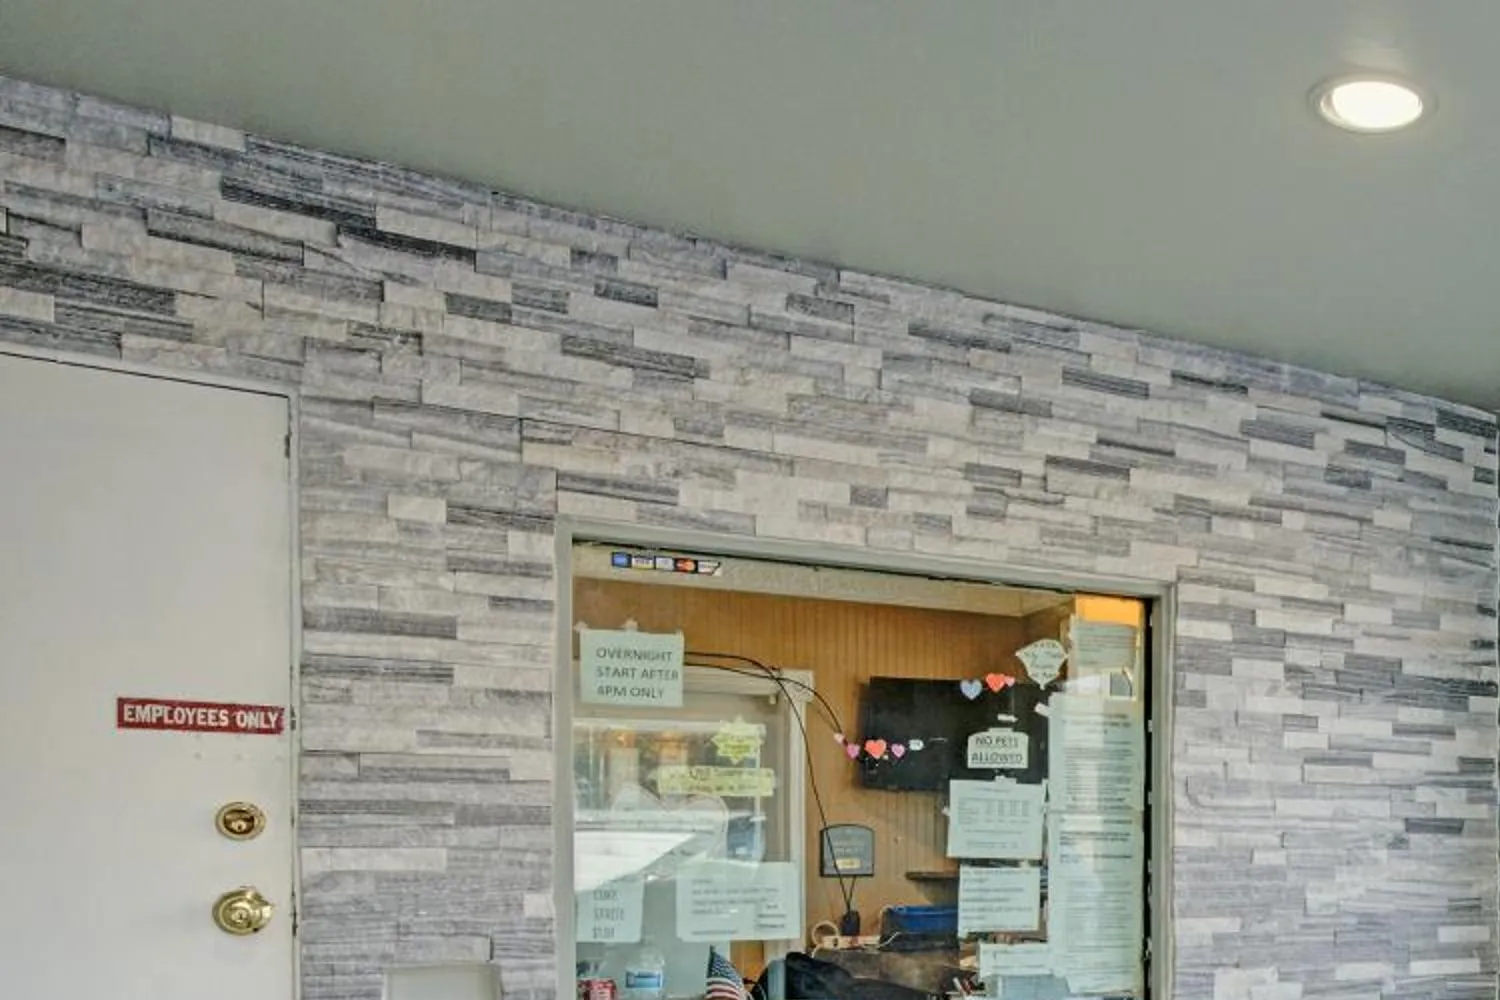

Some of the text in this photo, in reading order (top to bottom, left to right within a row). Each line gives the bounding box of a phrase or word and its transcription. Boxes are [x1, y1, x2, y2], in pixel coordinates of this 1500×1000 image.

[595, 647, 673, 661] OVERNIGHT
[595, 666, 679, 681] START AFTER
[629, 687, 665, 700] ONLY
[123, 703, 279, 729] EMPLOYEES ONLY
[975, 735, 992, 745] NO
